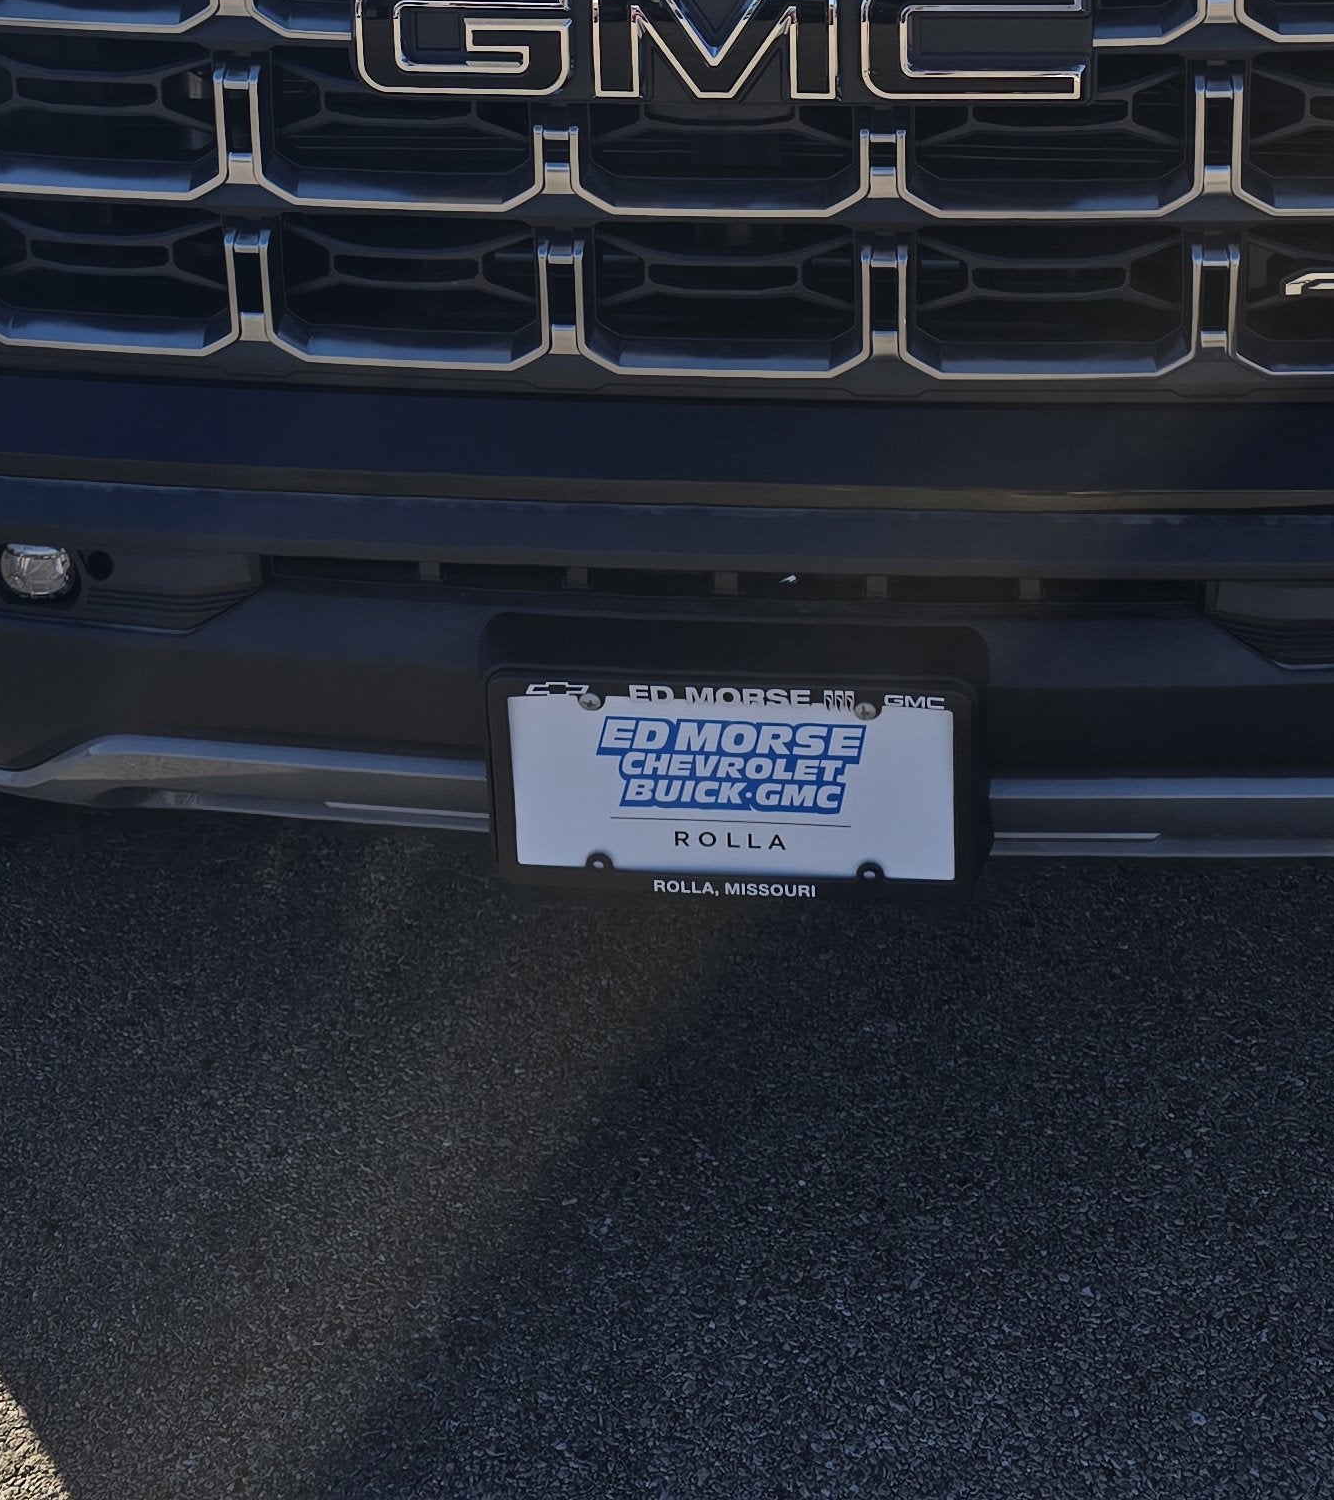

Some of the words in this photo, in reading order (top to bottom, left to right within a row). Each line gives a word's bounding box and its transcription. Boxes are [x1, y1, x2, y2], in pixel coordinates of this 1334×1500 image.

[628, 685, 674, 701] ED
[685, 686, 810, 707] MORSE
[884, 695, 945, 709] GMC
[601, 719, 670, 750] ED
[675, 722, 864, 757] MORSE
[621, 751, 844, 783] CHEVROLET
[674, 831, 786, 850] ROLLA
[653, 879, 720, 897] ROLLA,
[725, 882, 816, 898] MISSOURI
